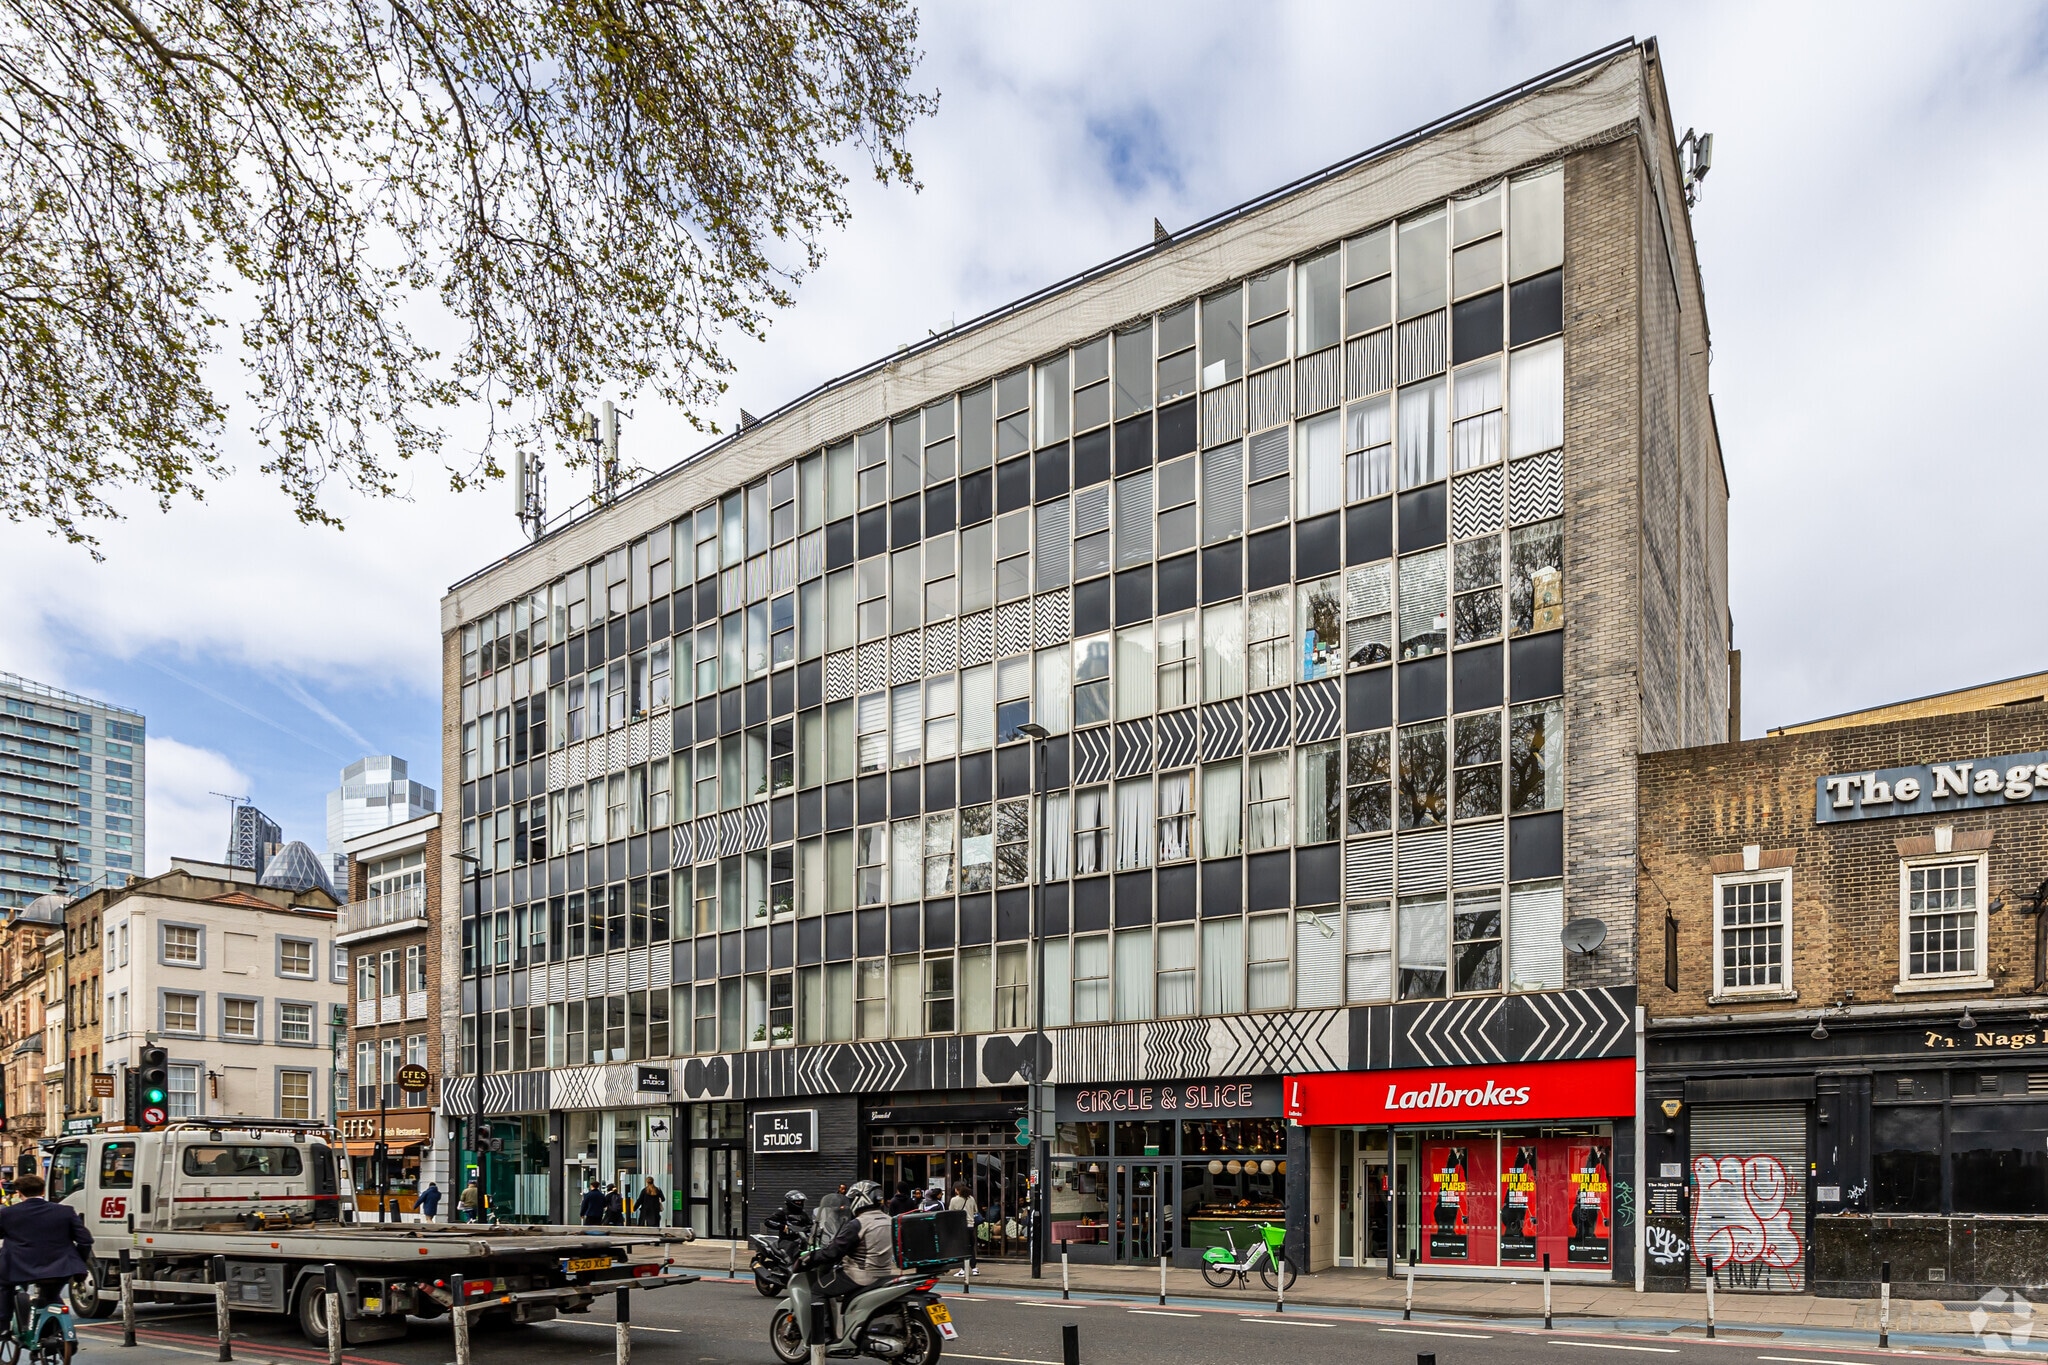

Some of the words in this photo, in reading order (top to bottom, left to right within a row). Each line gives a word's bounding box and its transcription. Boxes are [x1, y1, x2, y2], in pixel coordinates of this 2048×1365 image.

[1826, 772, 1921, 808] The
[1975, 1032, 2036, 1050] Nags
[402, 1070, 427, 1079] EFES
[1076, 1087, 1153, 1113] CIRCLE
[1161, 1087, 1177, 1110] &
[1184, 1083, 1253, 1109] SLICE
[1291, 1081, 1300, 1108] L
[1384, 1080, 1531, 1110] Ladbrokes
[343, 1118, 374, 1138] EFES
[395, 1127, 422, 1136] Restaurant
[763, 1133, 803, 1146] STUDIOS
[1433, 1174, 1450, 1182] WITH
[1451, 1174, 1458, 1182] 10
[1501, 1174, 1518, 1182] WITH
[1519, 1174, 1526, 1182] 10
[1571, 1174, 1590, 1182] WITH
[1591, 1174, 1599, 1182] 10
[1442, 1182, 1466, 1191] PLACES
[1509, 1182, 1534, 1191] PLACES
[1580, 1182, 1607, 1192] PLACES
[941, 1324, 953, 1335] L
